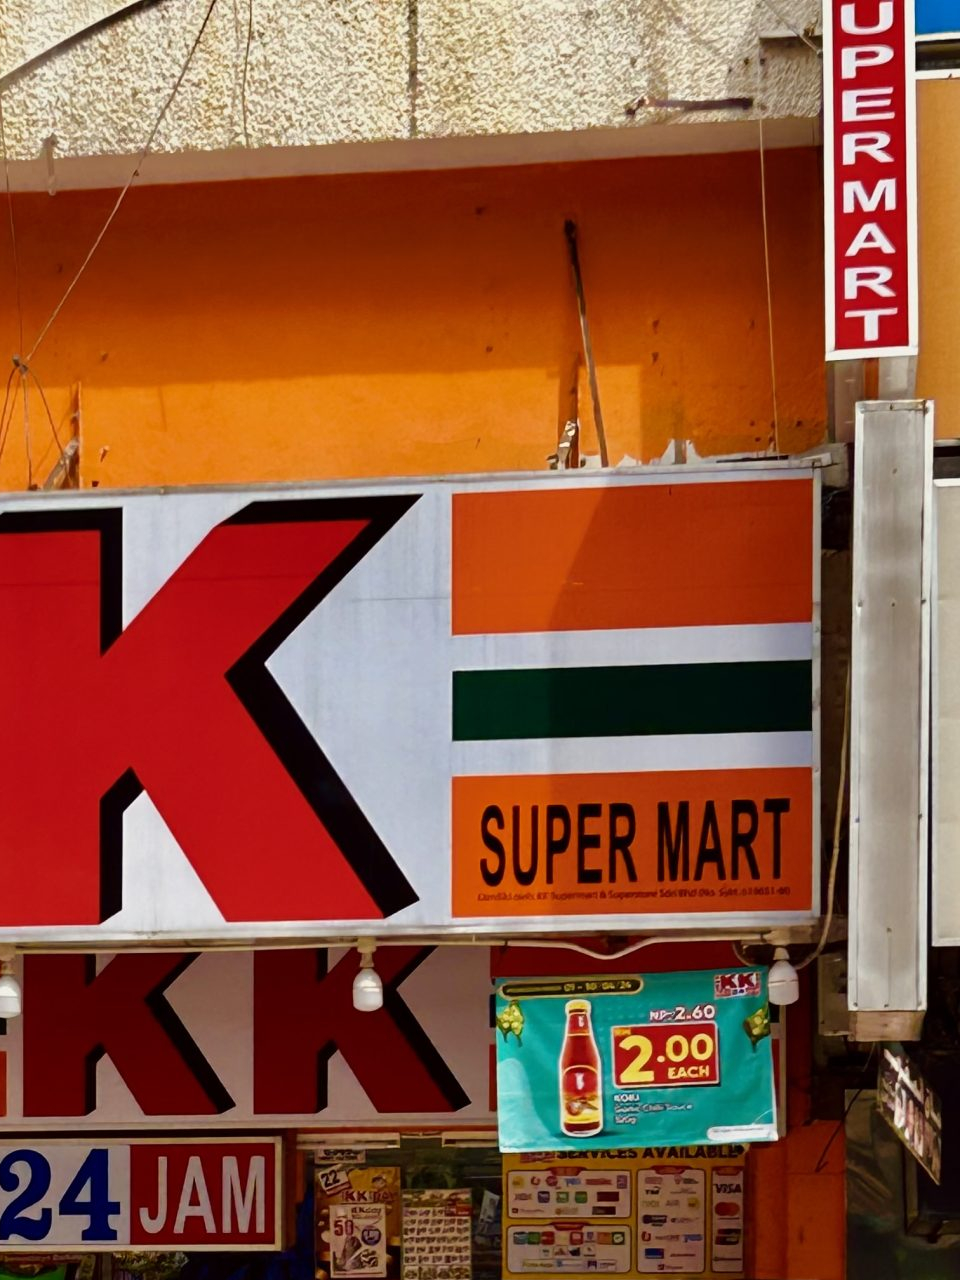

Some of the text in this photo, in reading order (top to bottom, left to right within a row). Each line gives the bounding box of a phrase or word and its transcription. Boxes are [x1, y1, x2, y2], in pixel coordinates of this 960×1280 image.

[840, 0, 898, 342] UPERMART
[479, 798, 791, 887] SUPER MART
[23, 946, 472, 1116] KK
[675, 1004, 716, 1021] 2.60
[619, 1033, 714, 1083] 2.00
[667, 1065, 710, 1080] EACH
[138, 1154, 267, 1235] JAM
